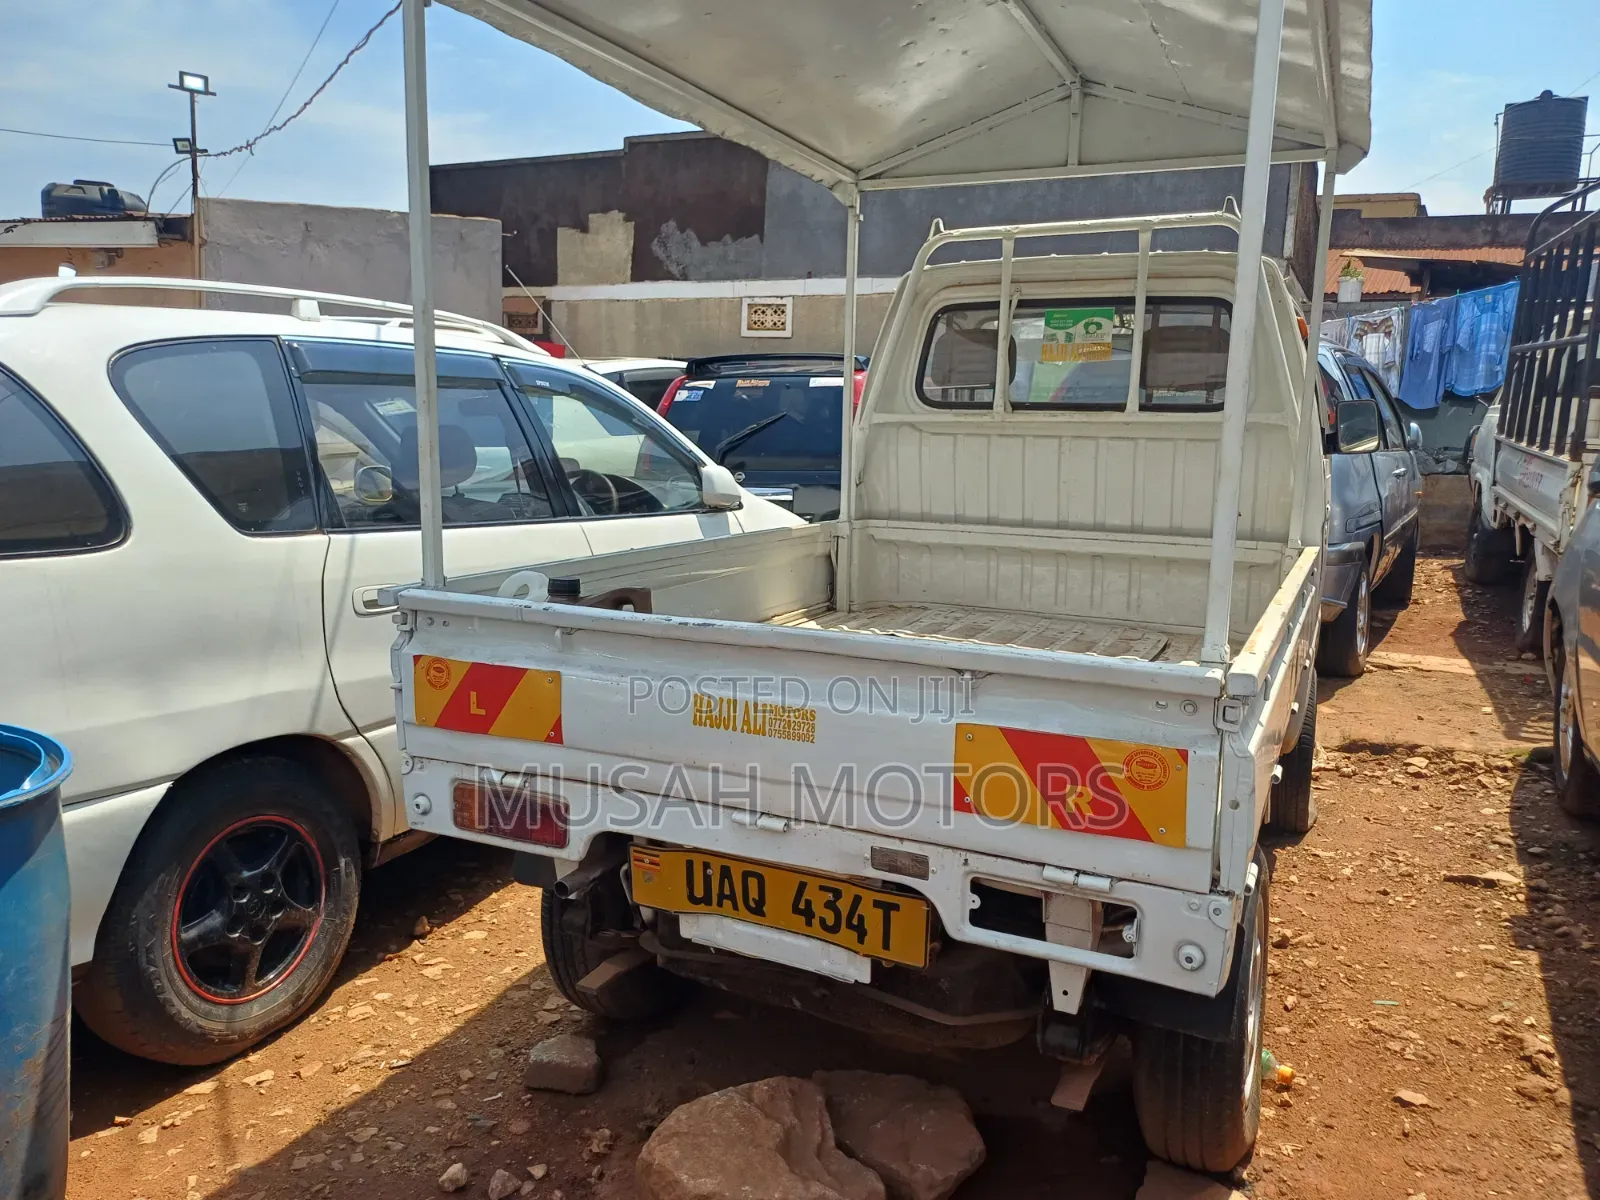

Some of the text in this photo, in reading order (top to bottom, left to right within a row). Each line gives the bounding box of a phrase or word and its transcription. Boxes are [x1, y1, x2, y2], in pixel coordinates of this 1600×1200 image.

[470, 690, 486, 716] L
[692, 693, 817, 737] HAJJI ALI MOTORS
[1066, 784, 1093, 817] R
[685, 858, 900, 951] UAQ 434T
